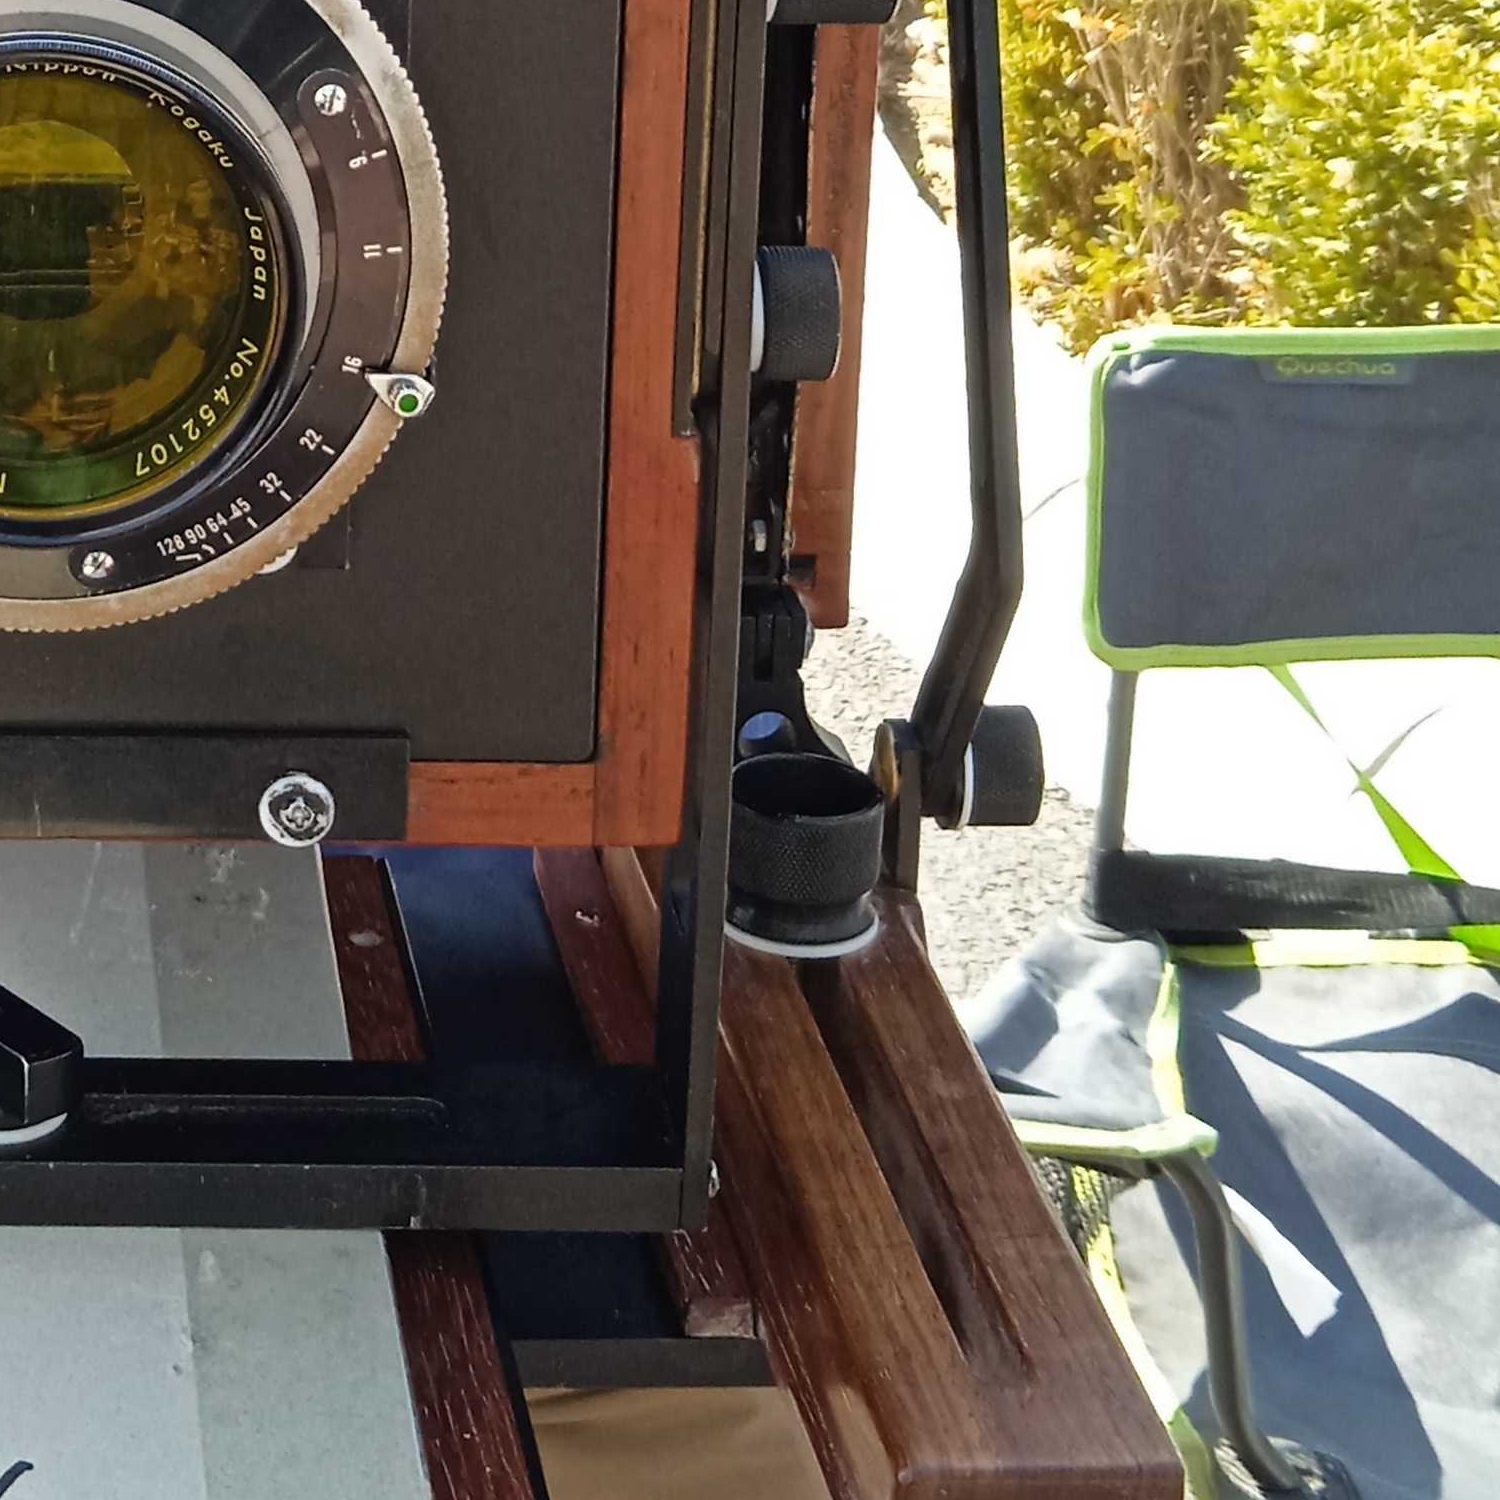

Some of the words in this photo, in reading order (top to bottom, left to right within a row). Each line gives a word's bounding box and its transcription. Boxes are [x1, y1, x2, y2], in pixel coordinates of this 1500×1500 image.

[349, 155, 369, 170] 9
[244, 206, 267, 301] Japan
[363, 244, 382, 259] 11
[341, 355, 363, 374] 16
[1276, 356, 1397, 376] Quechua
[299, 428, 323, 451] 22
[259, 472, 284, 495] 32
[229, 497, 252, 520] 45
[184, 523, 207, 545] 90
[206, 511, 229, 534] 64
[156, 533, 186, 557] 128
